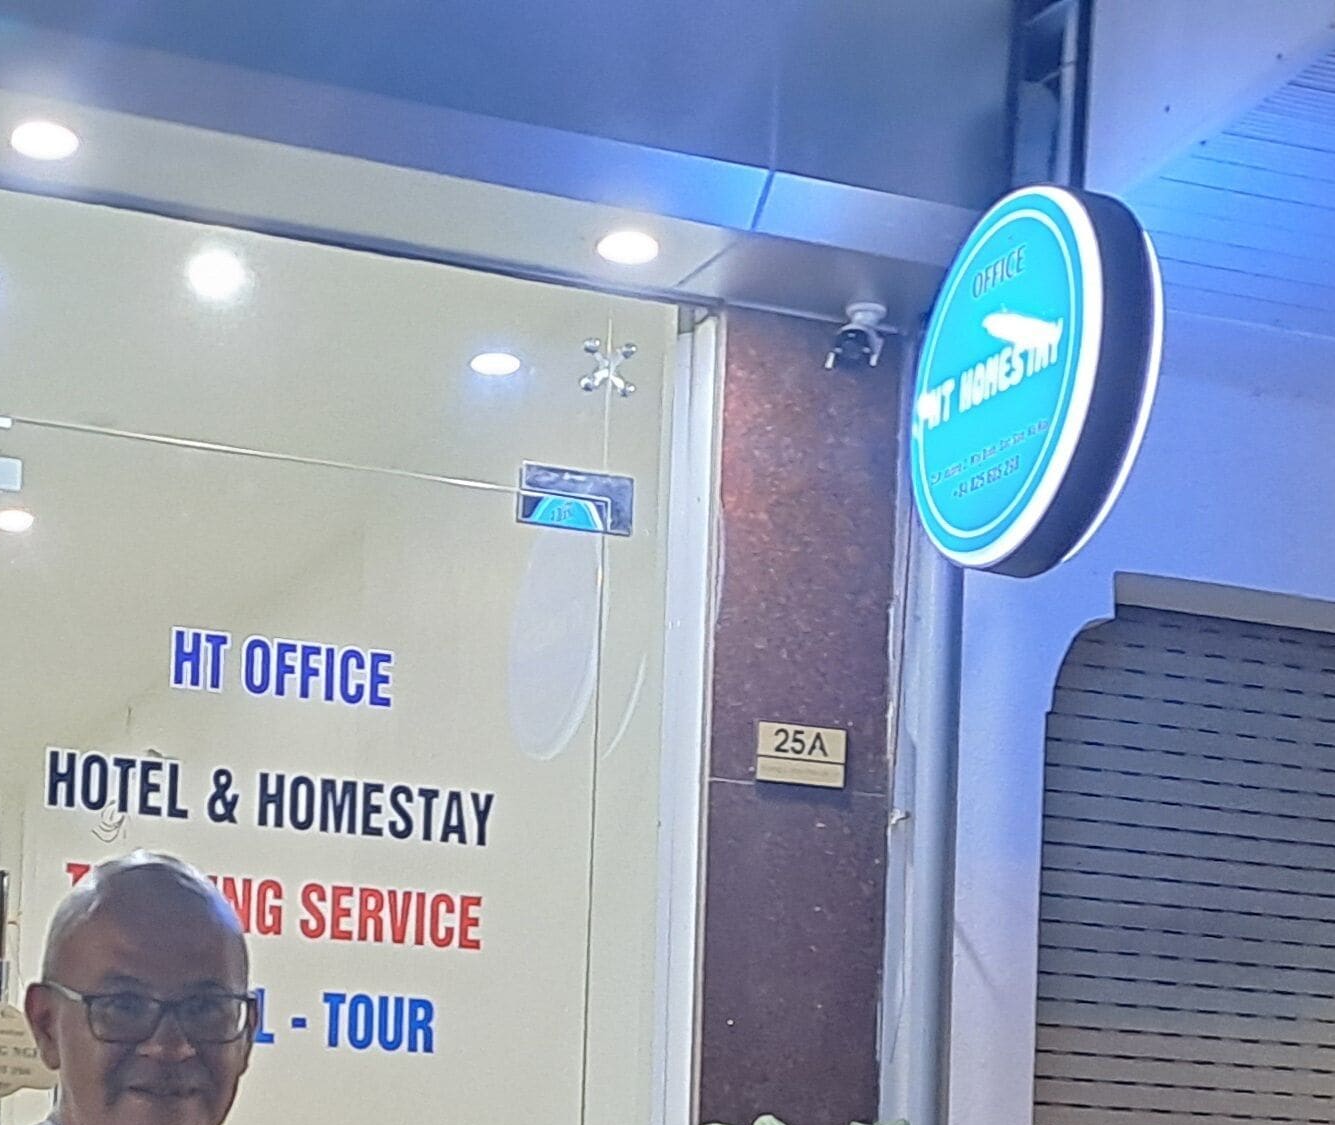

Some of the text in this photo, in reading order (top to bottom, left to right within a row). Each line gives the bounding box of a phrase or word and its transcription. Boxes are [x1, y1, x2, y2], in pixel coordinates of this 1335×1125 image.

[972, 244, 1027, 299] OFFICE
[172, 628, 394, 708] HT OFFICE
[774, 727, 830, 758] 25A
[46, 749, 496, 847] HOTEL & HOMESTAY
[298, 882, 484, 951] SERVICE
[322, 992, 435, 1054] TOUR
